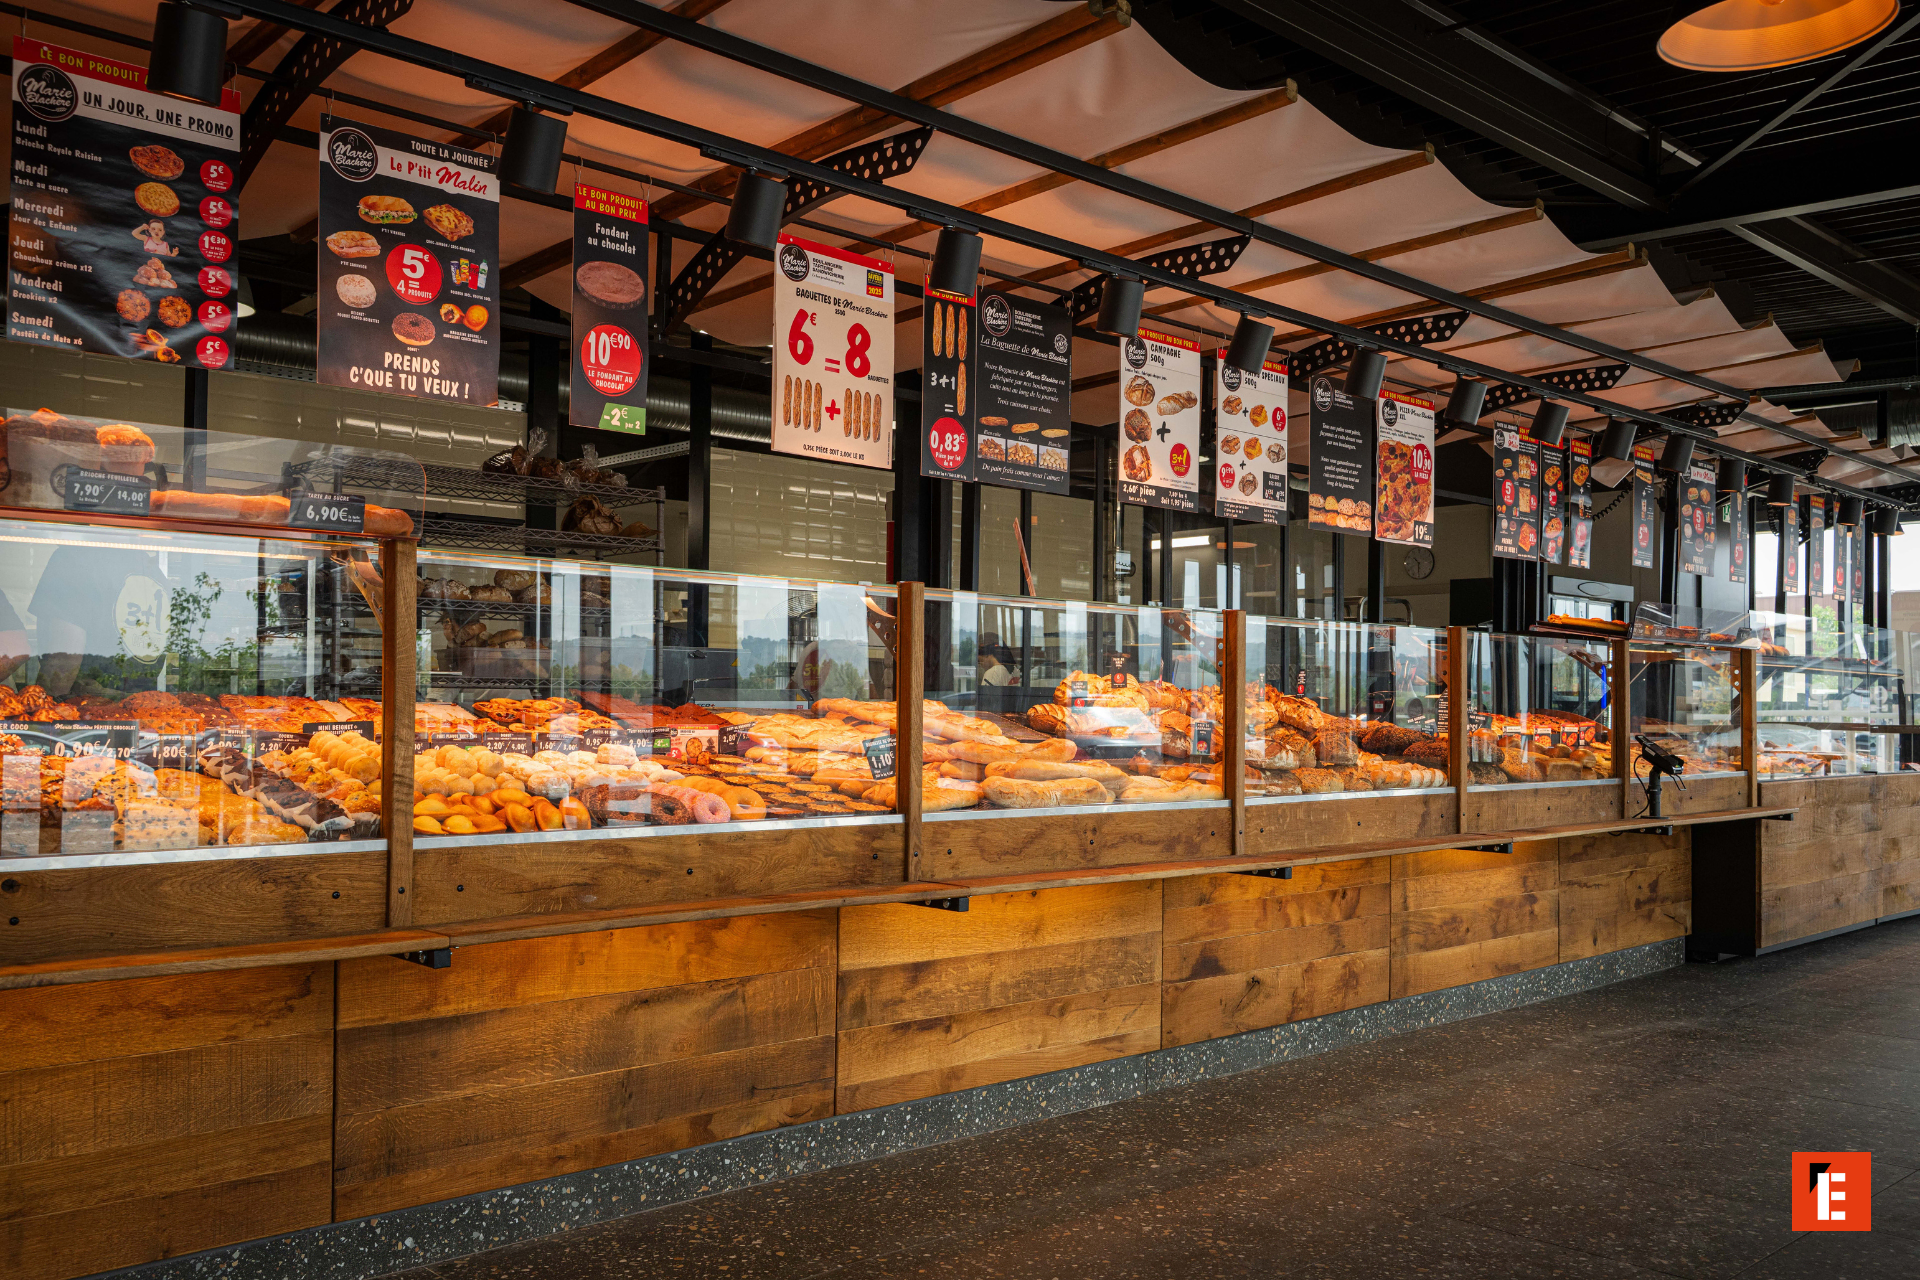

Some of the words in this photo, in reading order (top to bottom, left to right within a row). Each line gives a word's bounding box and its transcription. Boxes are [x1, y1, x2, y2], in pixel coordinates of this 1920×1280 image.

[40, 47, 53, 61] LE
[59, 53, 84, 69] BON
[89, 60, 140, 83] PRODUIT
[23, 77, 73, 100] Marie
[26, 92, 72, 108] Blachère
[83, 91, 102, 109] UN
[108, 97, 150, 121] JOUR,
[156, 108, 182, 128] UNE
[188, 116, 234, 139] PROMO
[15, 120, 48, 138] Lundi
[15, 136, 45, 151] Brioche
[47, 143, 73, 158] Royale
[75, 149, 102, 163] Raisins
[333, 142, 374, 160] Marie
[410, 140, 437, 156] TOUTE
[439, 147, 450, 159] LA
[451, 150, 489, 169] JOURNÉE
[15, 159, 48, 177] Mardi
[335, 154, 373, 168] Blachère
[209, 165, 224, 178] 5€
[390, 156, 403, 173] Le
[407, 160, 432, 180] P'tit
[436, 166, 488, 196] Malin
[14, 175, 35, 189] Tarte
[37, 181, 46, 190] au
[48, 184, 69, 194] sucre
[578, 186, 587, 197] LE
[590, 189, 607, 202] BON
[610, 194, 643, 210] PRODUIT
[14, 198, 64, 218] Mercredi
[209, 201, 224, 215] 5€
[585, 199, 596, 210] AU
[599, 203, 616, 215] BON
[619, 207, 637, 220] PRIX
[13, 213, 32, 227] Jour
[33, 217, 46, 230] des
[49, 220, 78, 233] Enfants
[595, 222, 630, 241] Fondant
[13, 235, 44, 252] Jeudi
[587, 236, 598, 247] au
[601, 238, 637, 255] chocolat
[13, 251, 53, 267] Chouchoux
[80, 264, 93, 273] x12
[402, 248, 430, 279] 5€
[782, 253, 807, 267] Marie
[13, 273, 63, 293] Vendredi
[208, 271, 223, 284] 5€
[12, 289, 46, 303] Brookies
[48, 296, 58, 304] x2
[396, 279, 406, 295] 4
[407, 288, 432, 300] PRODUITS
[868, 287, 882, 296] 2025
[796, 287, 832, 305] BAGUETTES
[833, 297, 842, 308] DE
[842, 299, 865, 314] Marie
[12, 311, 53, 329] Samedi
[208, 305, 223, 319] 5€
[985, 306, 1009, 320] Marie
[41, 332, 52, 341] de
[53, 333, 71, 344] Nata
[73, 337, 83, 346] x6
[788, 308, 817, 366] 6€
[845, 322, 871, 378] 8
[980, 335, 991, 345] La
[991, 337, 1021, 352] Baguette
[1021, 343, 1030, 354] de
[1031, 346, 1049, 359] Marie
[1146, 331, 1165, 342] PRODUIT
[1166, 335, 1172, 343] AU
[1173, 337, 1182, 346] BON
[1183, 340, 1193, 348] PRIX
[206, 341, 221, 355] 5€
[1150, 343, 1181, 359] CAMPAGNE
[384, 351, 440, 376] PRENDS
[1150, 353, 1165, 367] 500g
[350, 366, 393, 389] C'QUE
[399, 373, 417, 392] TU
[423, 376, 460, 398] VEUX
[588, 369, 595, 378] LE
[597, 371, 624, 382] FONDANT
[624, 376, 633, 384] AU
[595, 379, 625, 391] CHOCOLAT
[867, 374, 889, 385] BAGUETTES
[1244, 377, 1257, 389] 500g
[1261, 371, 1285, 385] SPÉCIAUX
[1399, 405, 1410, 414] PIZZA
[635, 421, 641, 430] 2
[930, 430, 966, 453] 0,83€
[829, 448, 839, 457] SOIT
[852, 452, 858, 460] LE
[1171, 448, 1188, 466] 3+1
[982, 463, 990, 471] Du
[80, 470, 106, 479] BRIOCHE
[107, 473, 139, 483] FEUILLETÉE
[73, 482, 105, 497] 7,90€
[117, 490, 148, 502] 14,00€
[1139, 484, 1156, 498] pièce
[1161, 496, 1170, 505] Soit
[1181, 499, 1194, 510] pièce
[306, 504, 349, 522] 6,90€
[10, 723, 29, 731] COCO
[106, 746, 135, 759] 2,70€
[151, 745, 187, 760] 1,80€
[260, 742, 283, 752] 2,20€
[671, 750, 678, 758] 5€
[871, 750, 895, 769] 1,10€
